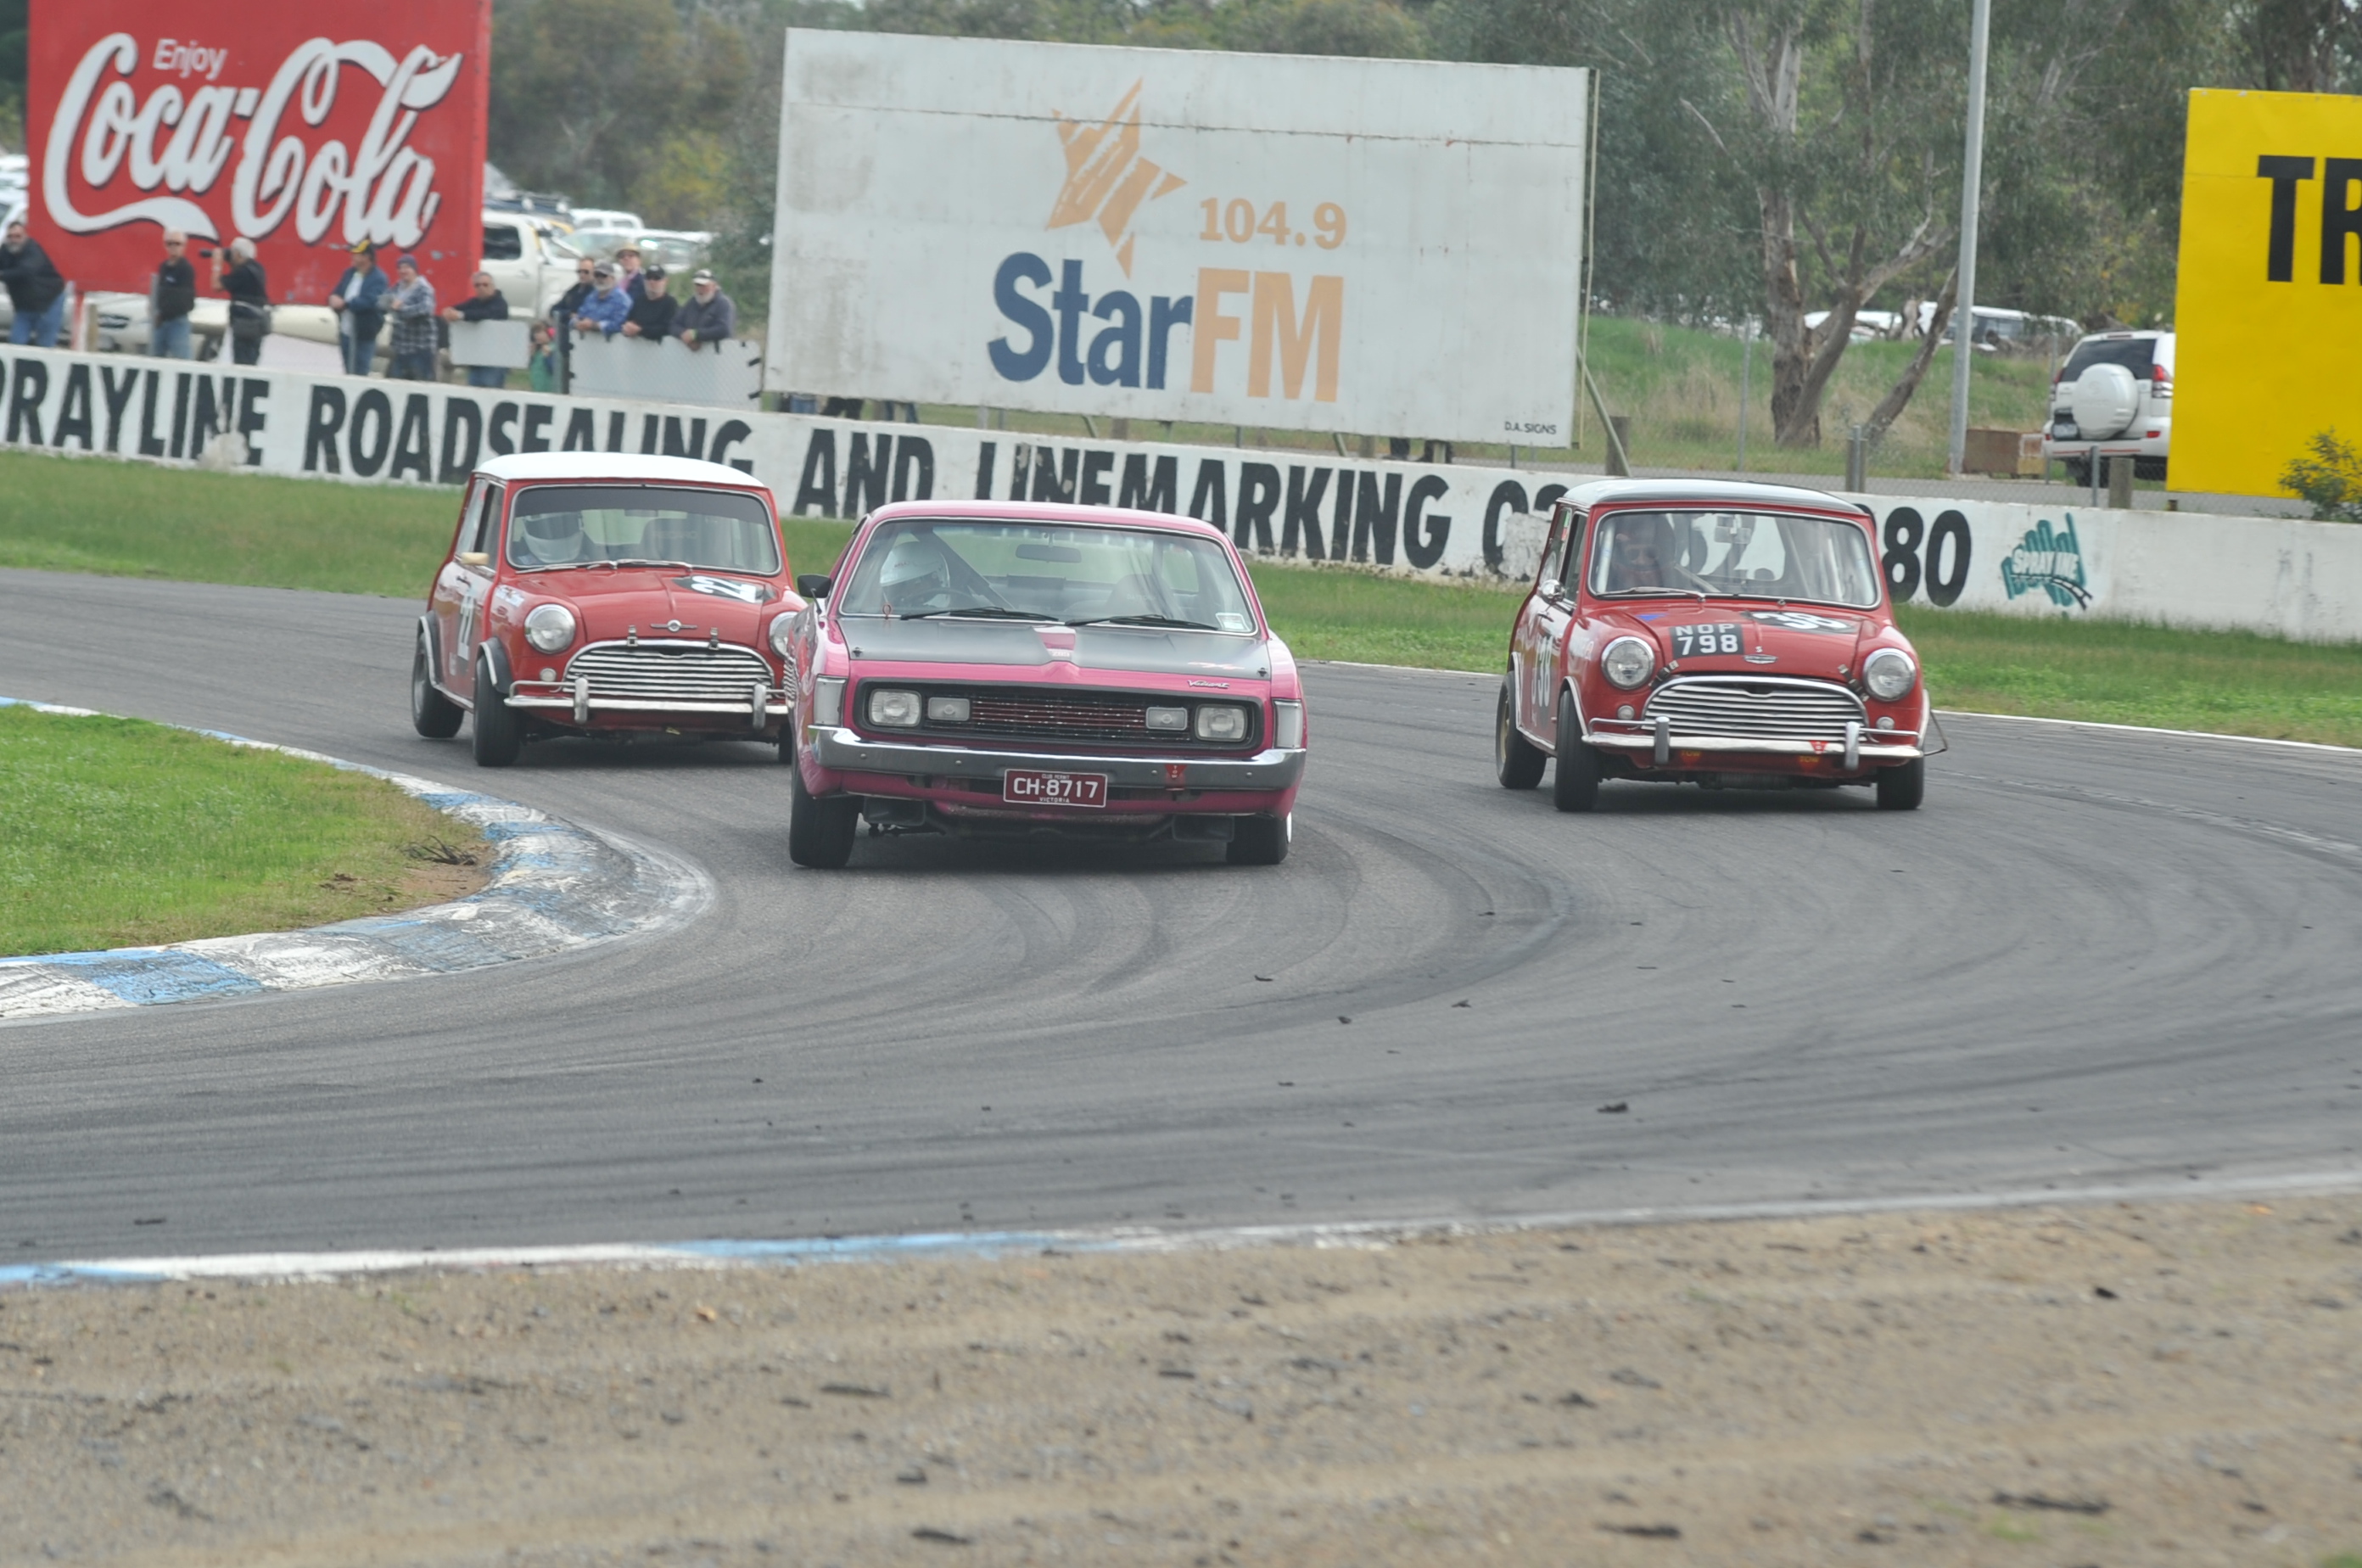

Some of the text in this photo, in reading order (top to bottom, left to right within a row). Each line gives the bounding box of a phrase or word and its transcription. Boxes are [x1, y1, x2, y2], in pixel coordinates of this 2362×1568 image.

[153, 38, 227, 80] Enjoy
[43, 32, 463, 249] Coca-Cola
[1199, 197, 1347, 249] 104.9
[0, 356, 270, 467] RAYLINE
[792, 428, 934, 519] AND
[1524, 423, 1557, 435] SIGNS
[1675, 623, 1736, 636] NOP
[1676, 635, 1738, 656] 798
